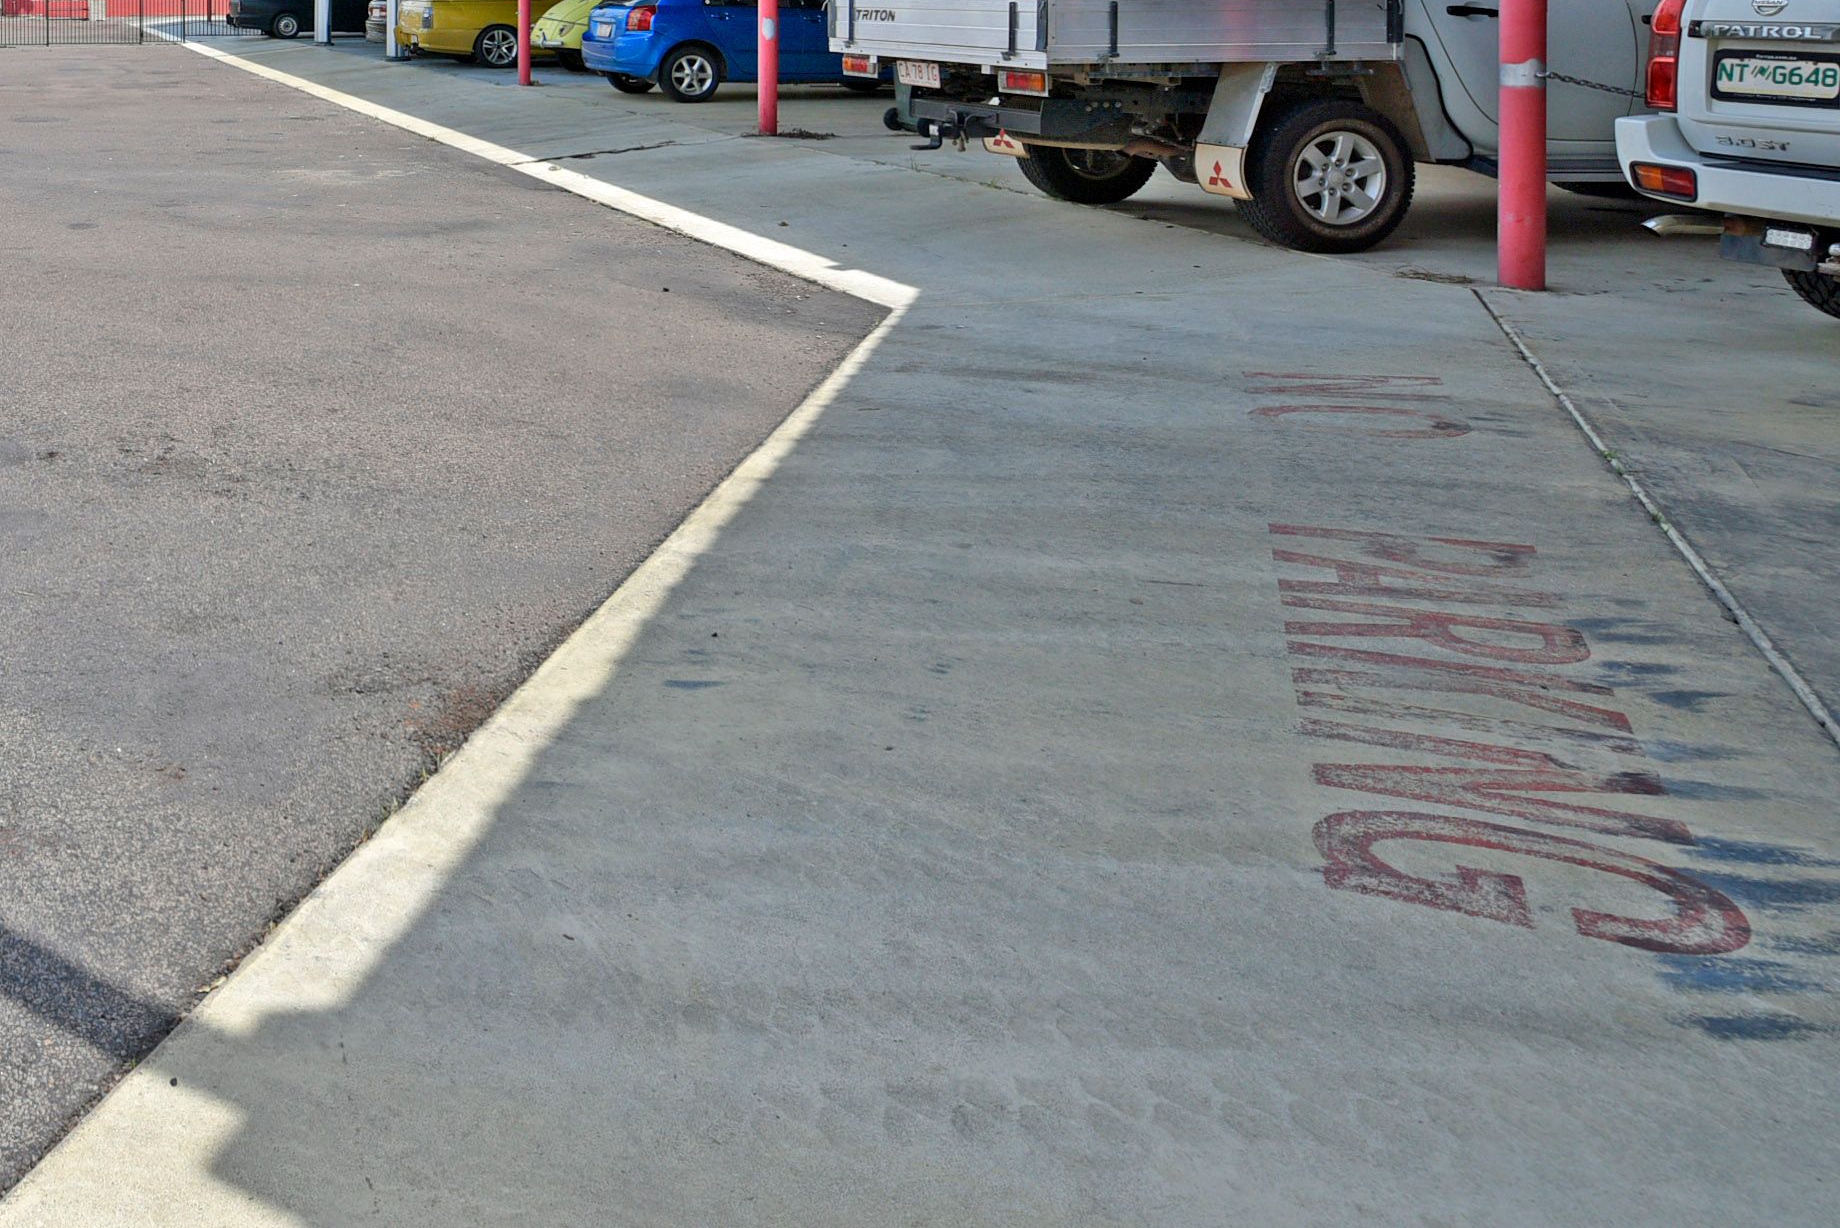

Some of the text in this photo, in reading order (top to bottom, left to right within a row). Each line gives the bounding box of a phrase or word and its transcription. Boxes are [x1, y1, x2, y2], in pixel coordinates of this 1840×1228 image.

[856, 9, 895, 22] TRITON
[1713, 24, 1822, 39] PATROL
[1718, 62, 1750, 82] NT
[1267, 523, 1753, 955] PARKING
